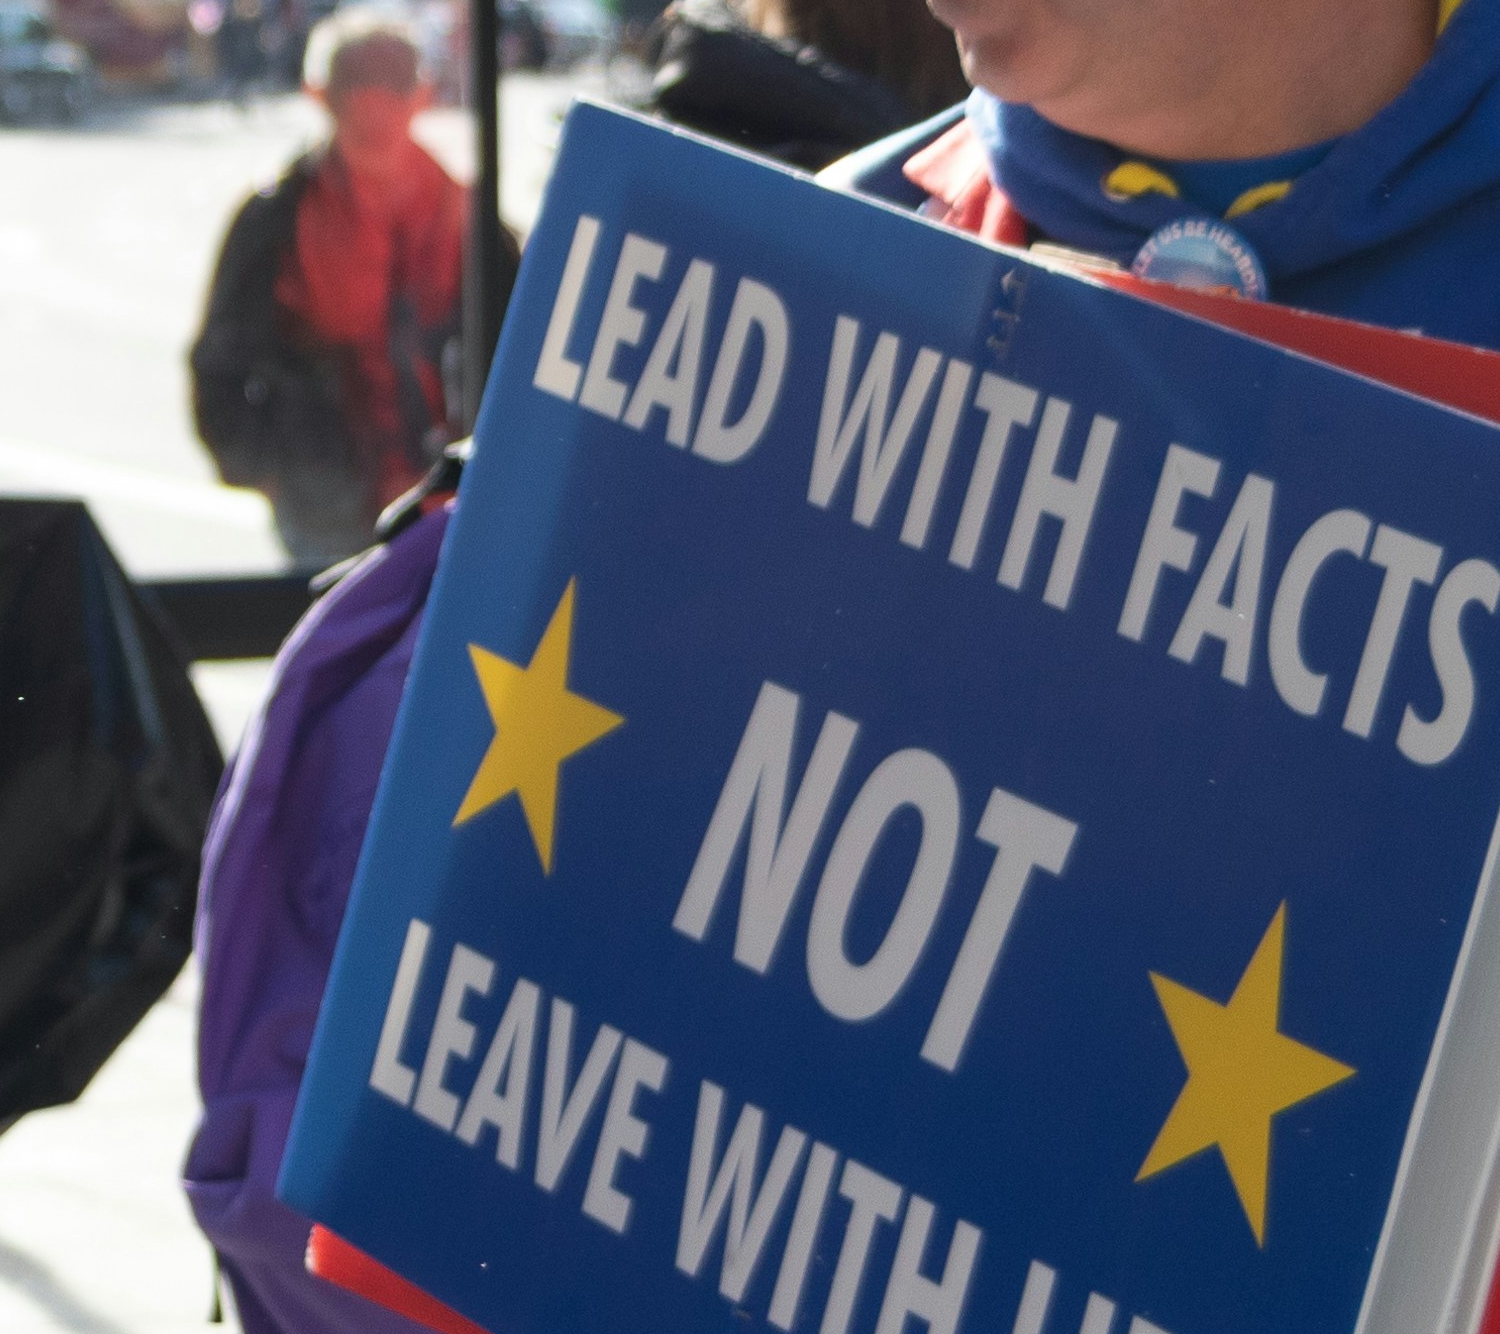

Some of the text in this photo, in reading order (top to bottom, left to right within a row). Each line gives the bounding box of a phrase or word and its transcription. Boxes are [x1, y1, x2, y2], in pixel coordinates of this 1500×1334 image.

[532, 213, 793, 468] LEAD
[805, 314, 1117, 611] WITH
[671, 681, 1079, 1073] NOT
[369, 919, 668, 1236] LEAVE
